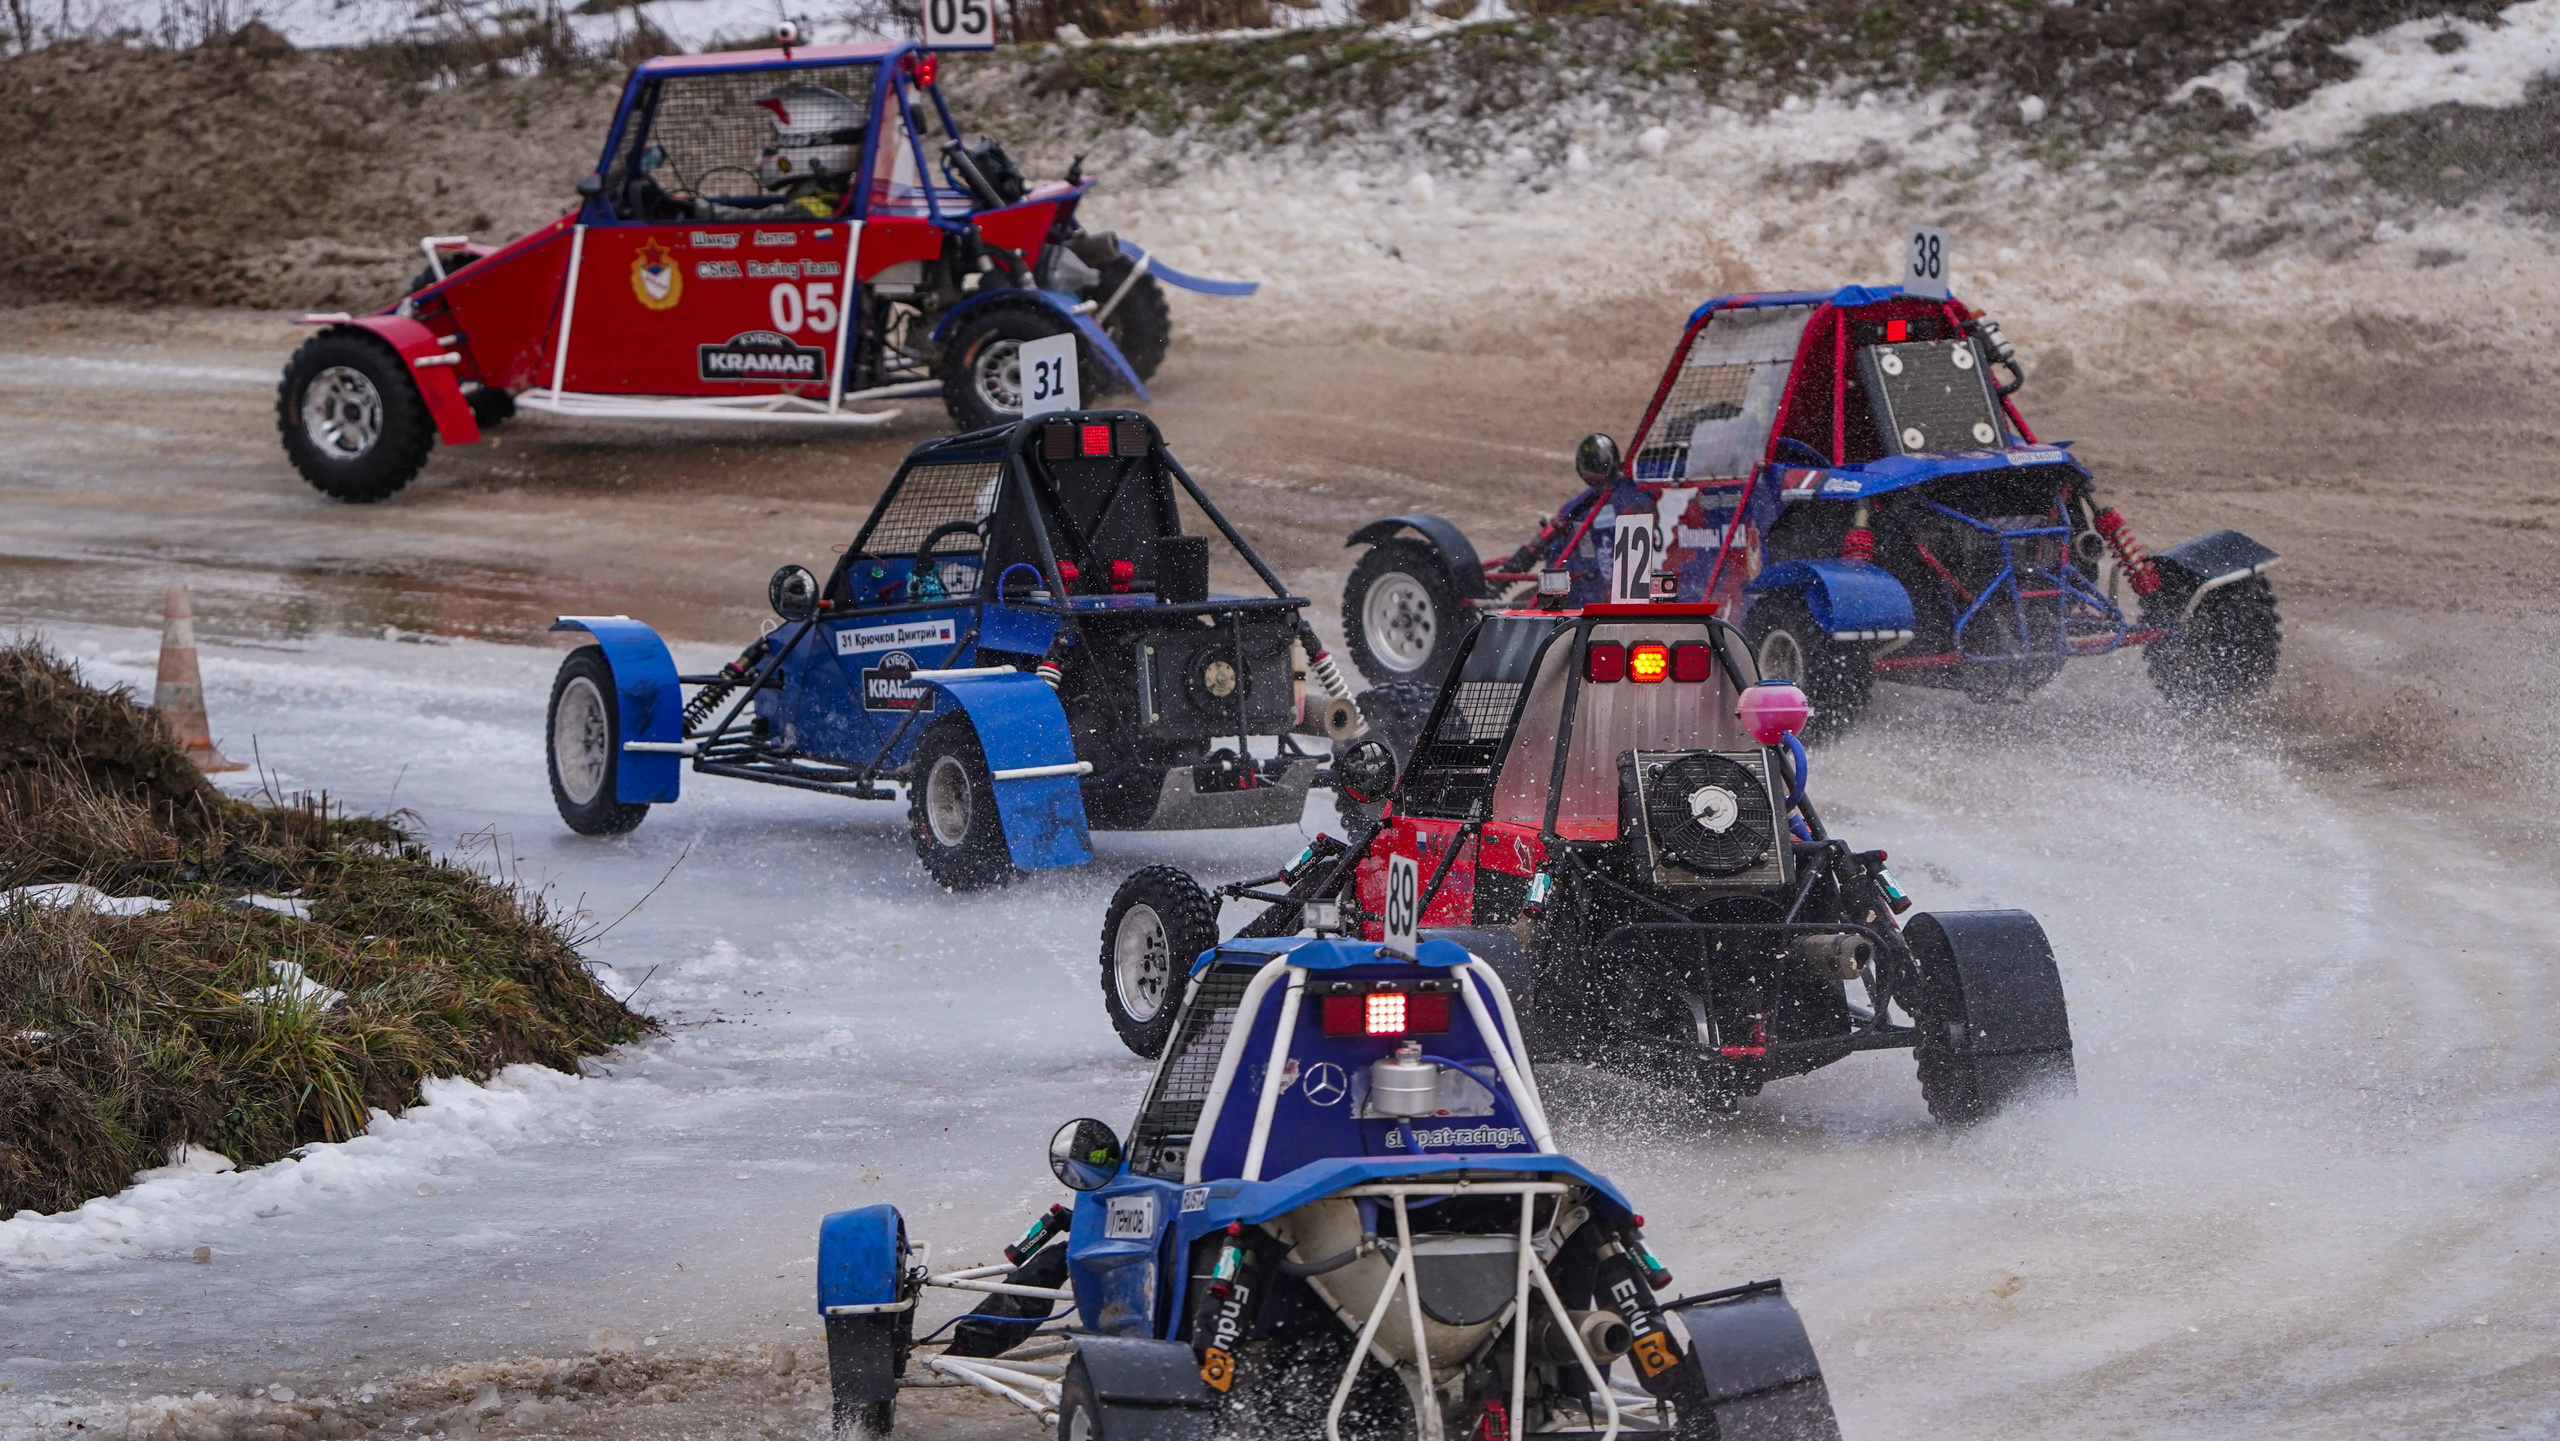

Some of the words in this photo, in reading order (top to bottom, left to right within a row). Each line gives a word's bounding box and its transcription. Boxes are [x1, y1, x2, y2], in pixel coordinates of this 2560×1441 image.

[930, 0, 987, 34] 05
[690, 232, 740, 248] Шмидт
[754, 231, 797, 245] Антон
[1913, 232, 1941, 279] 38
[697, 261, 743, 278] CSKA
[747, 260, 798, 280] Racing
[801, 259, 840, 275] Team
[769, 283, 838, 333] 05
[739, 333, 783, 346] КУБОК
[708, 353, 815, 372] KRAMAR
[1034, 356, 1064, 400] 31
[1615, 526, 1651, 599] 12
[842, 634, 852, 647] 31
[855, 631, 895, 648] Крючков
[898, 626, 937, 643] Дмитрий
[885, 655, 911, 669] КУБОК
[1389, 861, 1414, 937] 89
[1386, 1125, 1527, 1148] sp.at-racing.r
